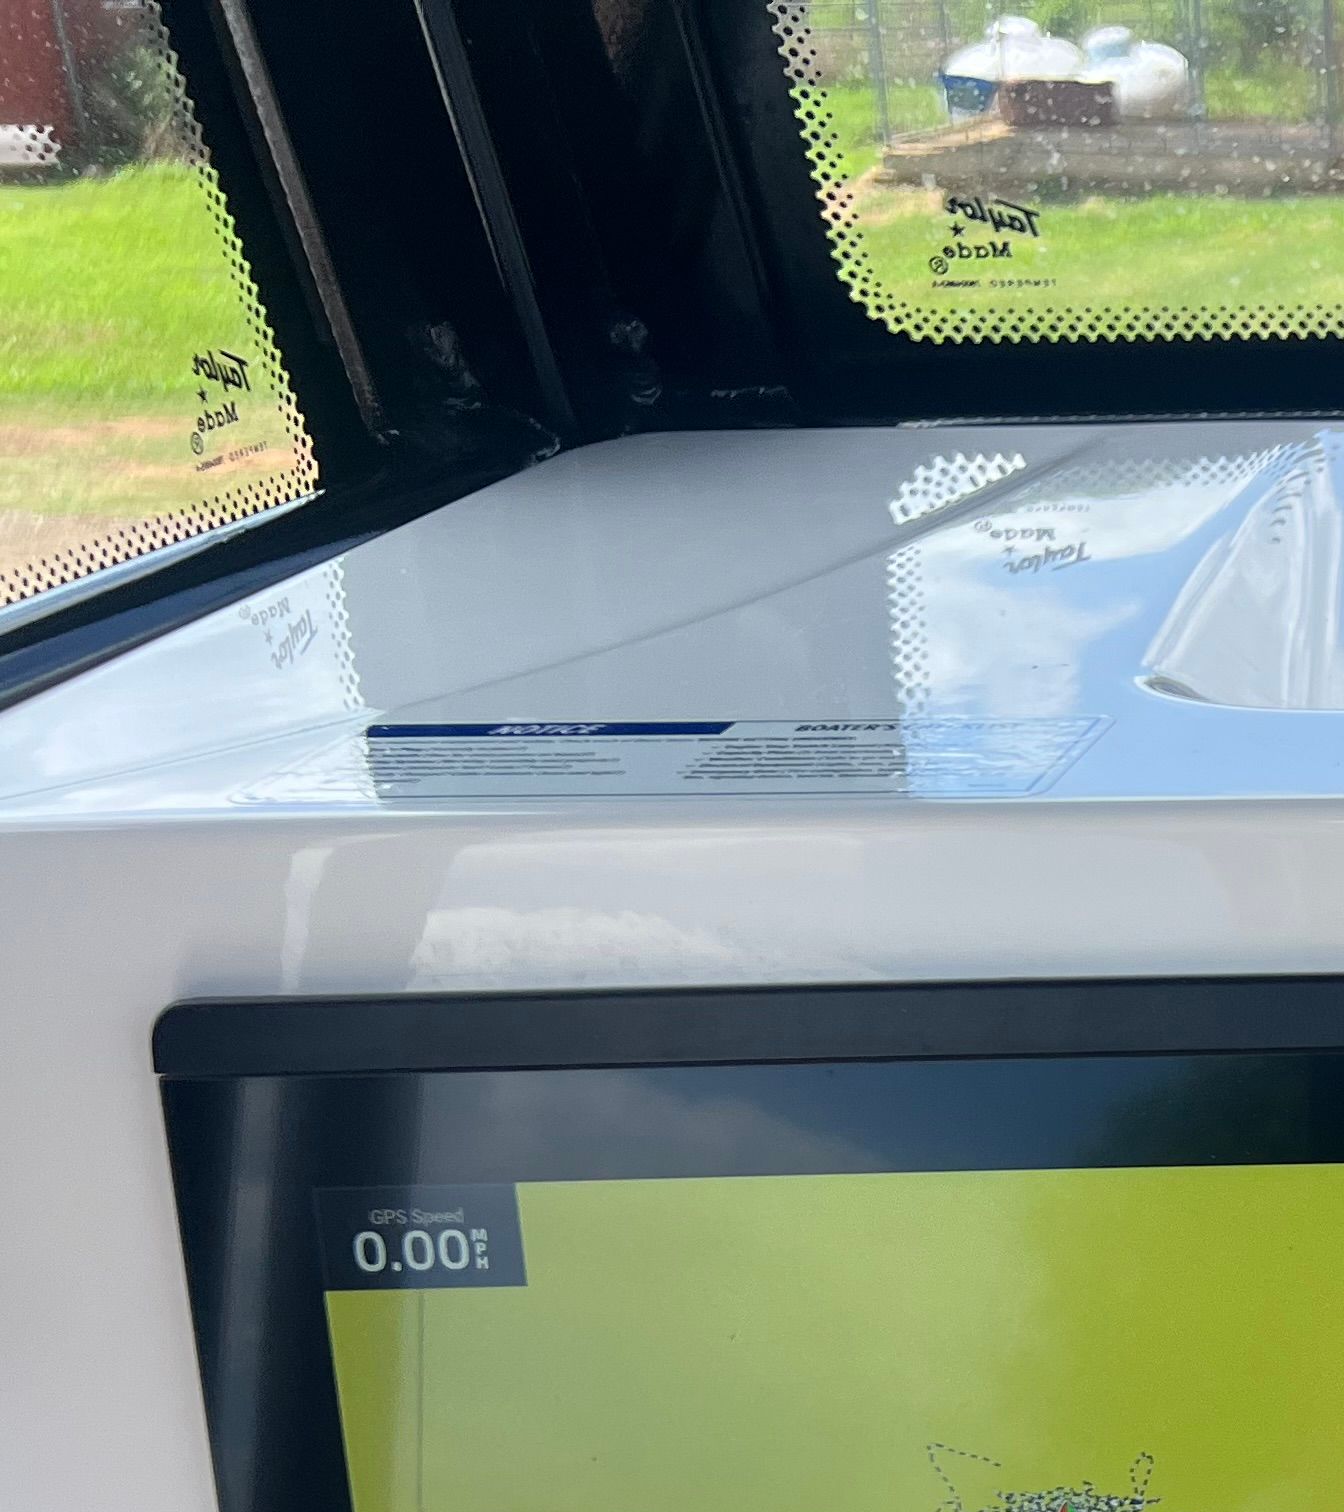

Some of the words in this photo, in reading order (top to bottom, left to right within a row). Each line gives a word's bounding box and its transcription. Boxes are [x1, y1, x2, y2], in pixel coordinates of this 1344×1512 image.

[795, 723, 898, 732] BOATER'S
[369, 1207, 408, 1226] GPS
[411, 1206, 465, 1226] Speed
[353, 1228, 470, 1273] 0.00
